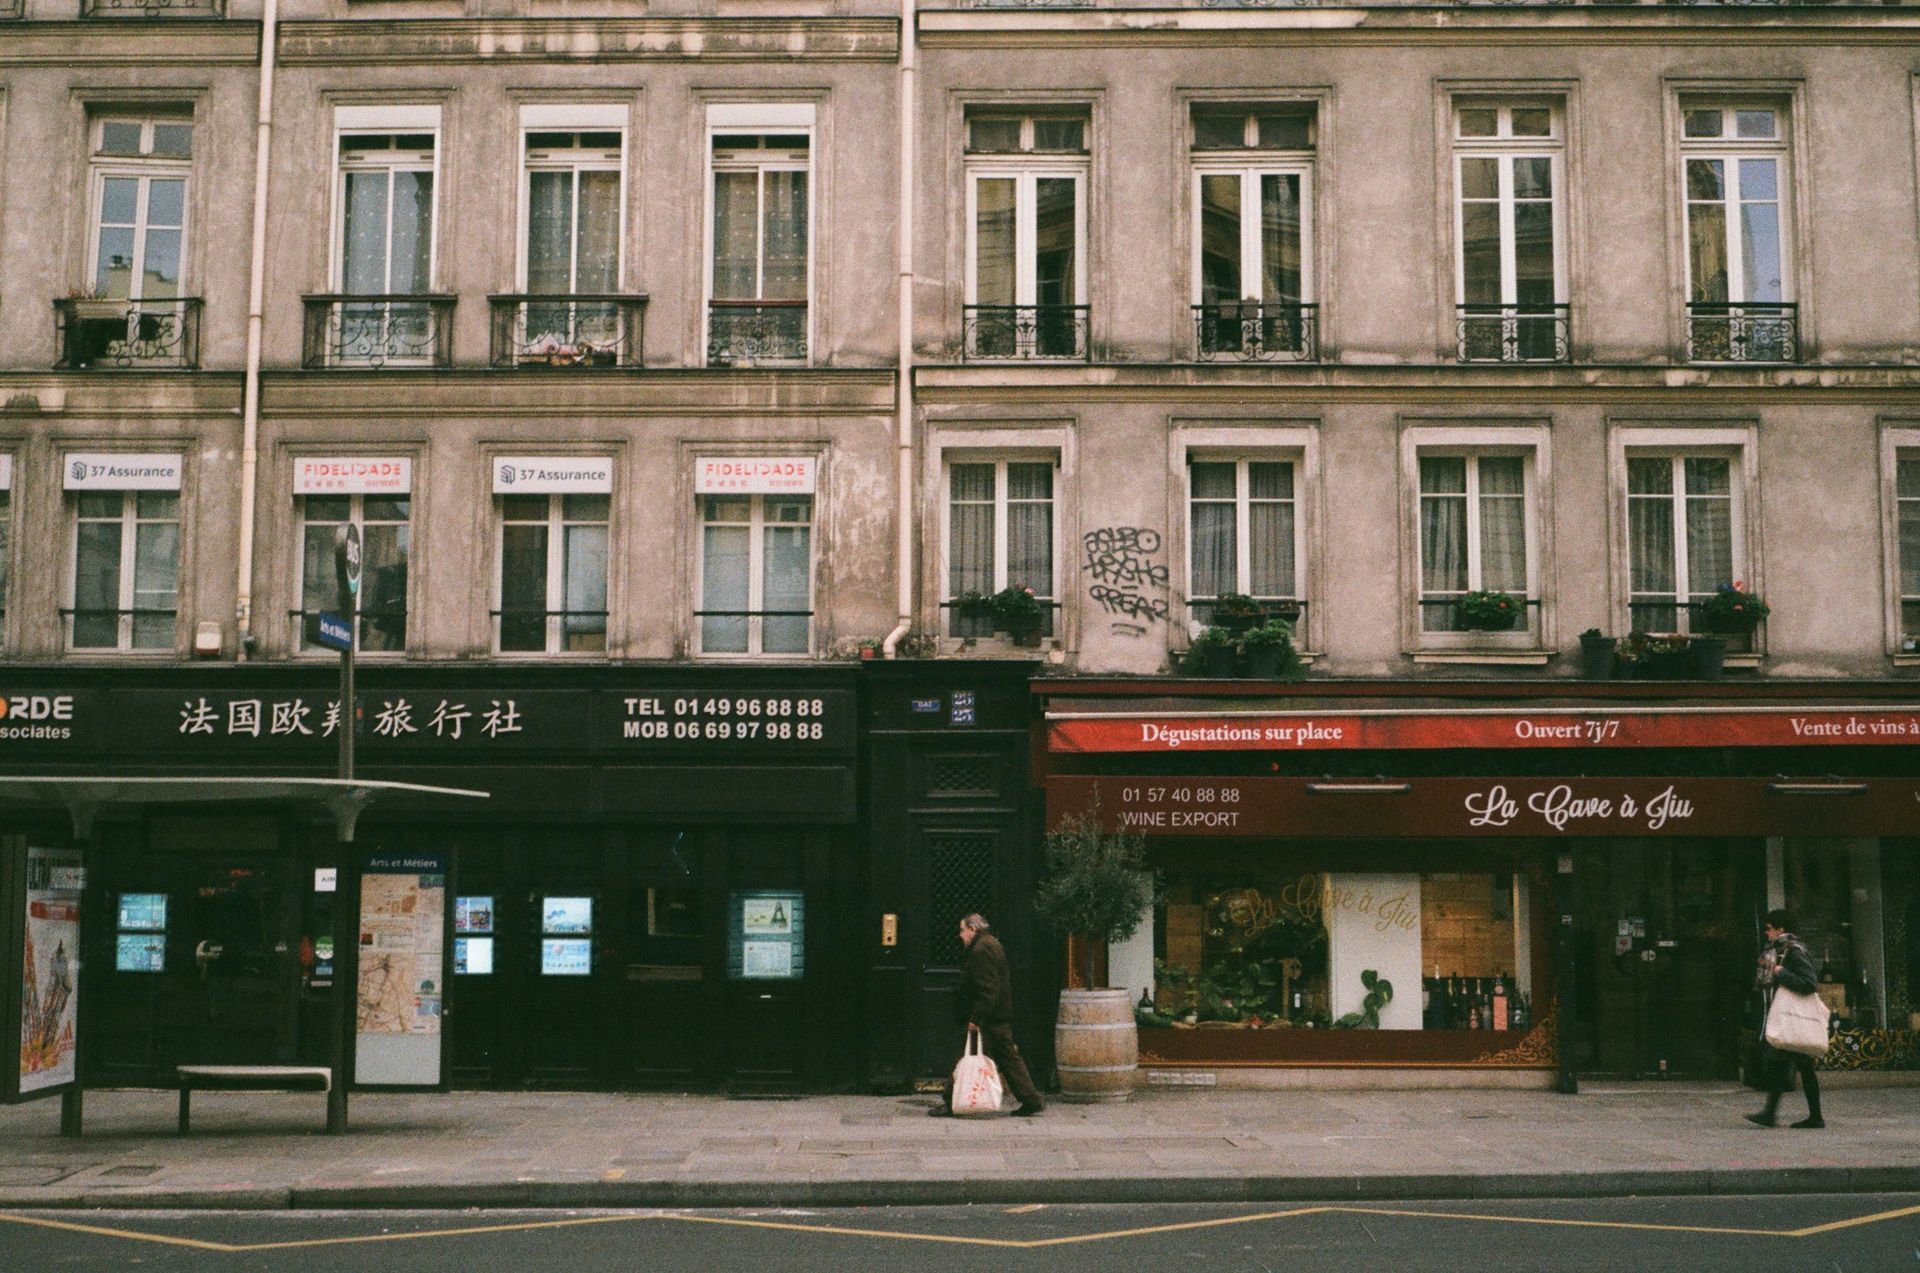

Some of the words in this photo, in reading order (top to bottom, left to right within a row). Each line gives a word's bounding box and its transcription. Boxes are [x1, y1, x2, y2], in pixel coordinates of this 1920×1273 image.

[91, 466, 106, 477] 37
[108, 466, 174, 477] Assurance
[304, 464, 401, 475] FIDELIDADE
[520, 470, 535, 480] 37
[538, 470, 606, 480] Assurance
[706, 464, 805, 475] FIDELIDADE
[624, 699, 665, 715] TEL
[675, 699, 698, 715] 01
[704, 699, 730, 715] 49
[736, 700, 761, 716] 96
[766, 700, 791, 716] 88
[797, 700, 823, 716] 88
[624, 722, 669, 738] MOB
[674, 722, 700, 739] 06
[705, 722, 731, 739] 69
[736, 722, 760, 739] 97
[766, 723, 791, 739] 98
[797, 723, 823, 739] 88
[1515, 720, 1581, 738] Ouvert
[1585, 721, 1619, 743] 7j/7
[1790, 718, 1841, 735] Vente
[1845, 717, 1866, 735] de
[1870, 719, 1905, 734] vins
[1909, 718, 1919, 734] à
[1141, 724, 1261, 746] Dégustations
[1265, 728, 1293, 740] sur
[1296, 722, 1343, 745] place
[1122, 788, 1139, 802] 01
[1147, 788, 1166, 802] 57
[1171, 788, 1190, 802] 40
[1196, 788, 1215, 802] 88
[1221, 788, 1240, 802] 88
[1465, 785, 1519, 826] La
[1528, 785, 1613, 830] Cave
[1620, 794, 1638, 818] à
[1645, 785, 1694, 829] Jiu
[1122, 812, 1166, 826] WINE
[1171, 812, 1240, 826] EXPORT
[370, 859, 389, 867] Arts
[403, 859, 438, 867] Métiers
